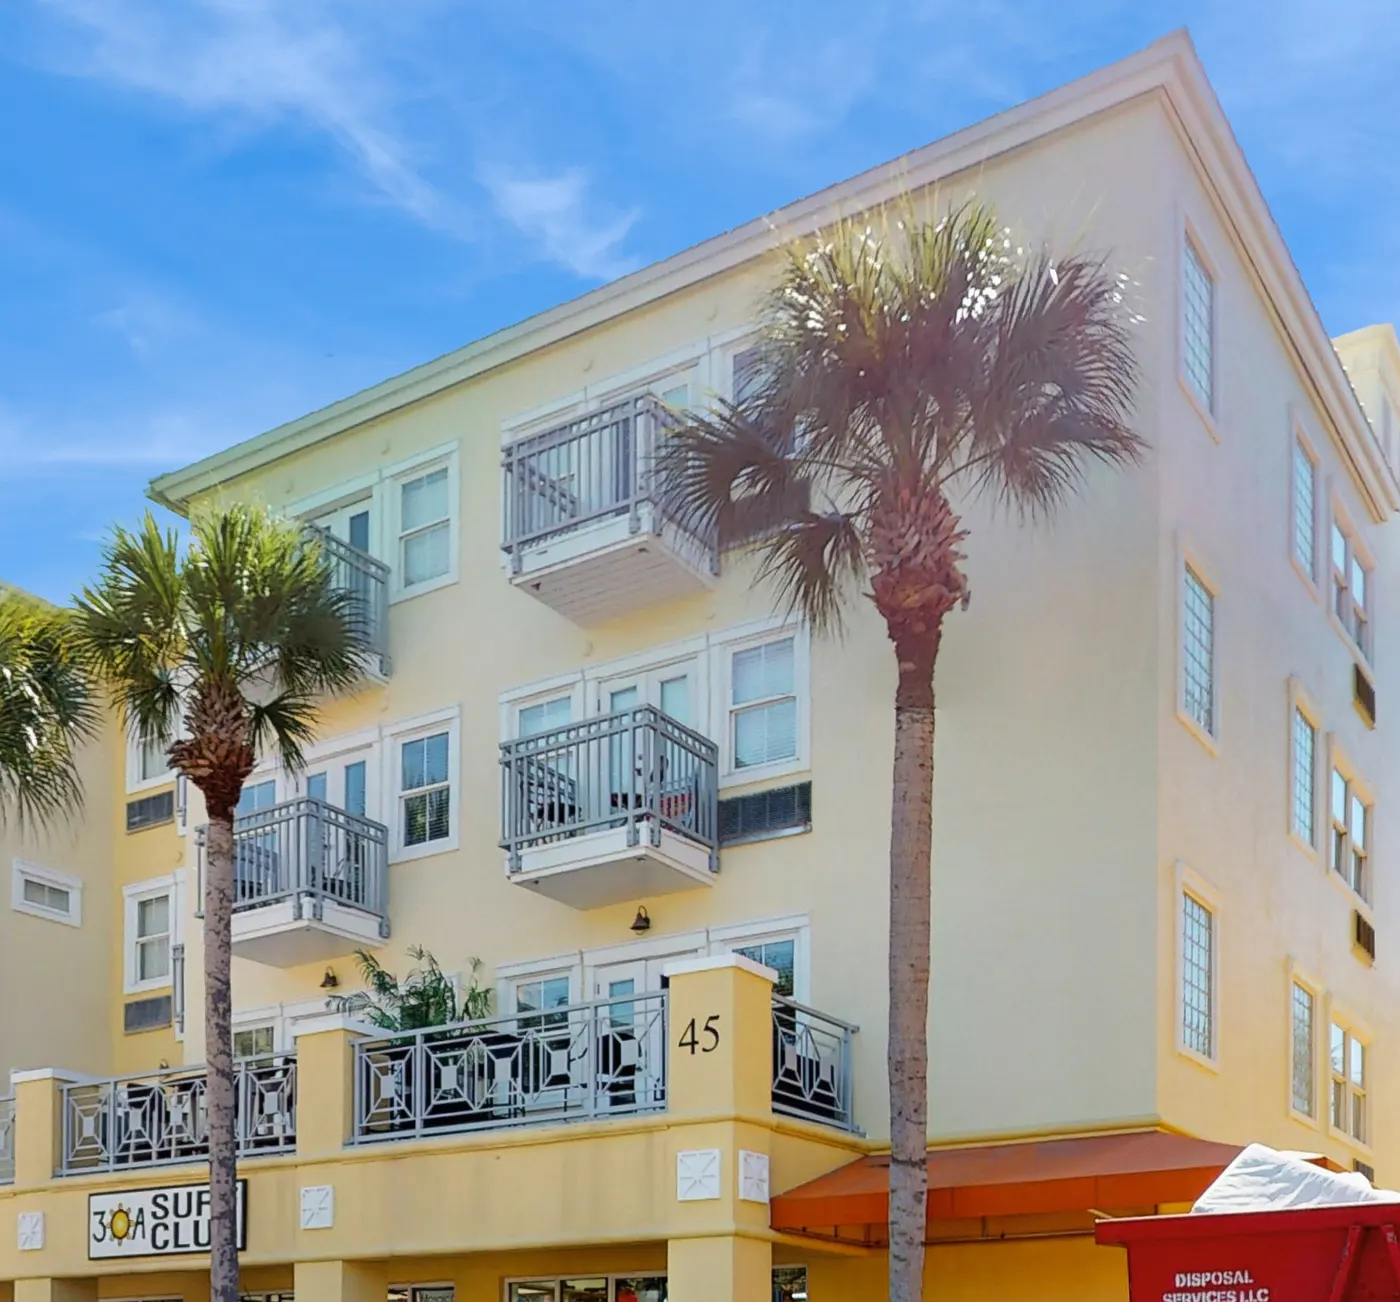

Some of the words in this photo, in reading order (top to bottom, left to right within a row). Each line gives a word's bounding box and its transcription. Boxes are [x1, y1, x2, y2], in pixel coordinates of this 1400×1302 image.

[678, 1014, 720, 1055] 45
[151, 1219, 212, 1250] CLU
[1175, 1270, 1254, 1288] DISPOSAL
